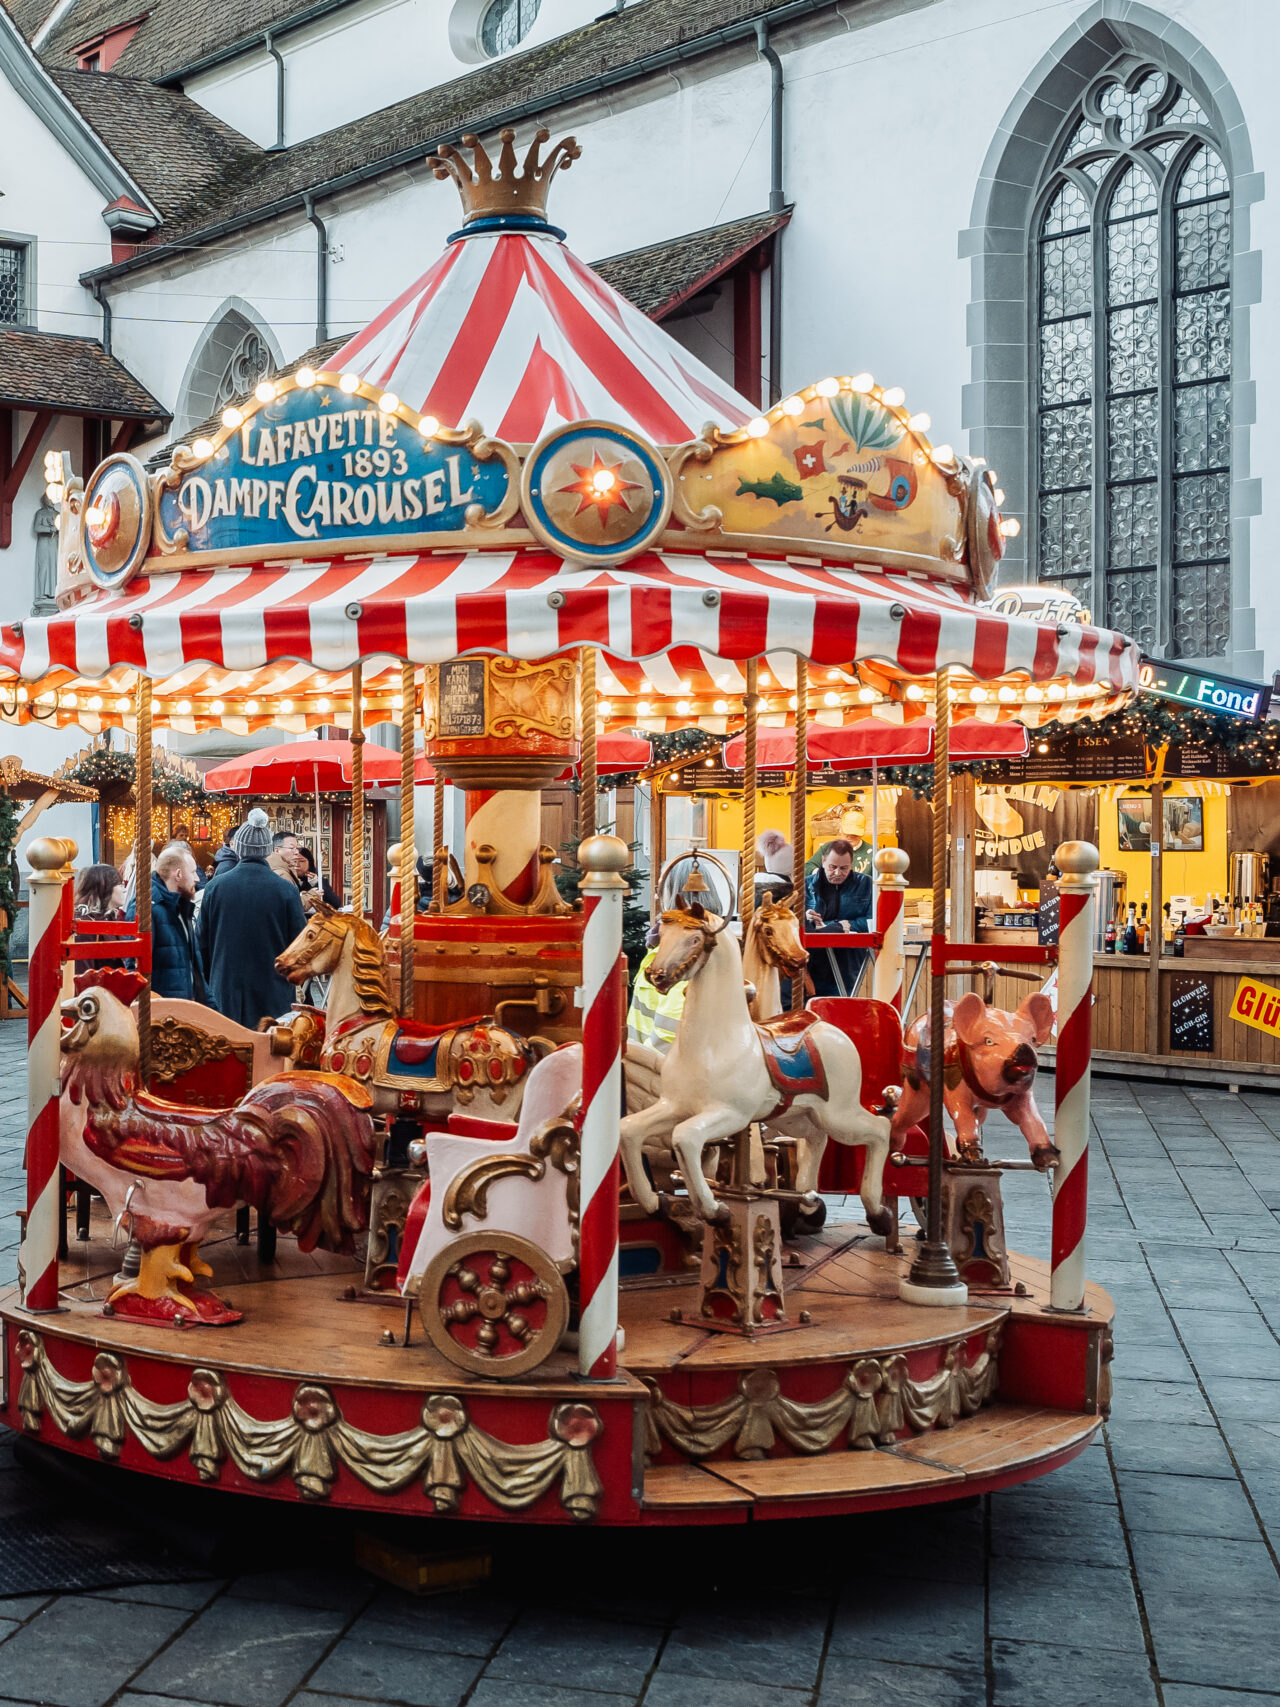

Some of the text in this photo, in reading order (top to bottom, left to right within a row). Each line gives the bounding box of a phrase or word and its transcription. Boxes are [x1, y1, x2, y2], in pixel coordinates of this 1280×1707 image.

[240, 408, 398, 467] LAFAYETTE
[342, 448, 409, 478] 1893
[1139, 665, 1168, 689] 0.-
[1196, 679, 1260, 714] Fond
[975, 830, 1046, 858] FONDUE
[1172, 983, 1208, 1008] GLÜHWEIN
[1236, 985, 1280, 1030] Glü
[1175, 1012, 1208, 1034] GLÜH-GIN
